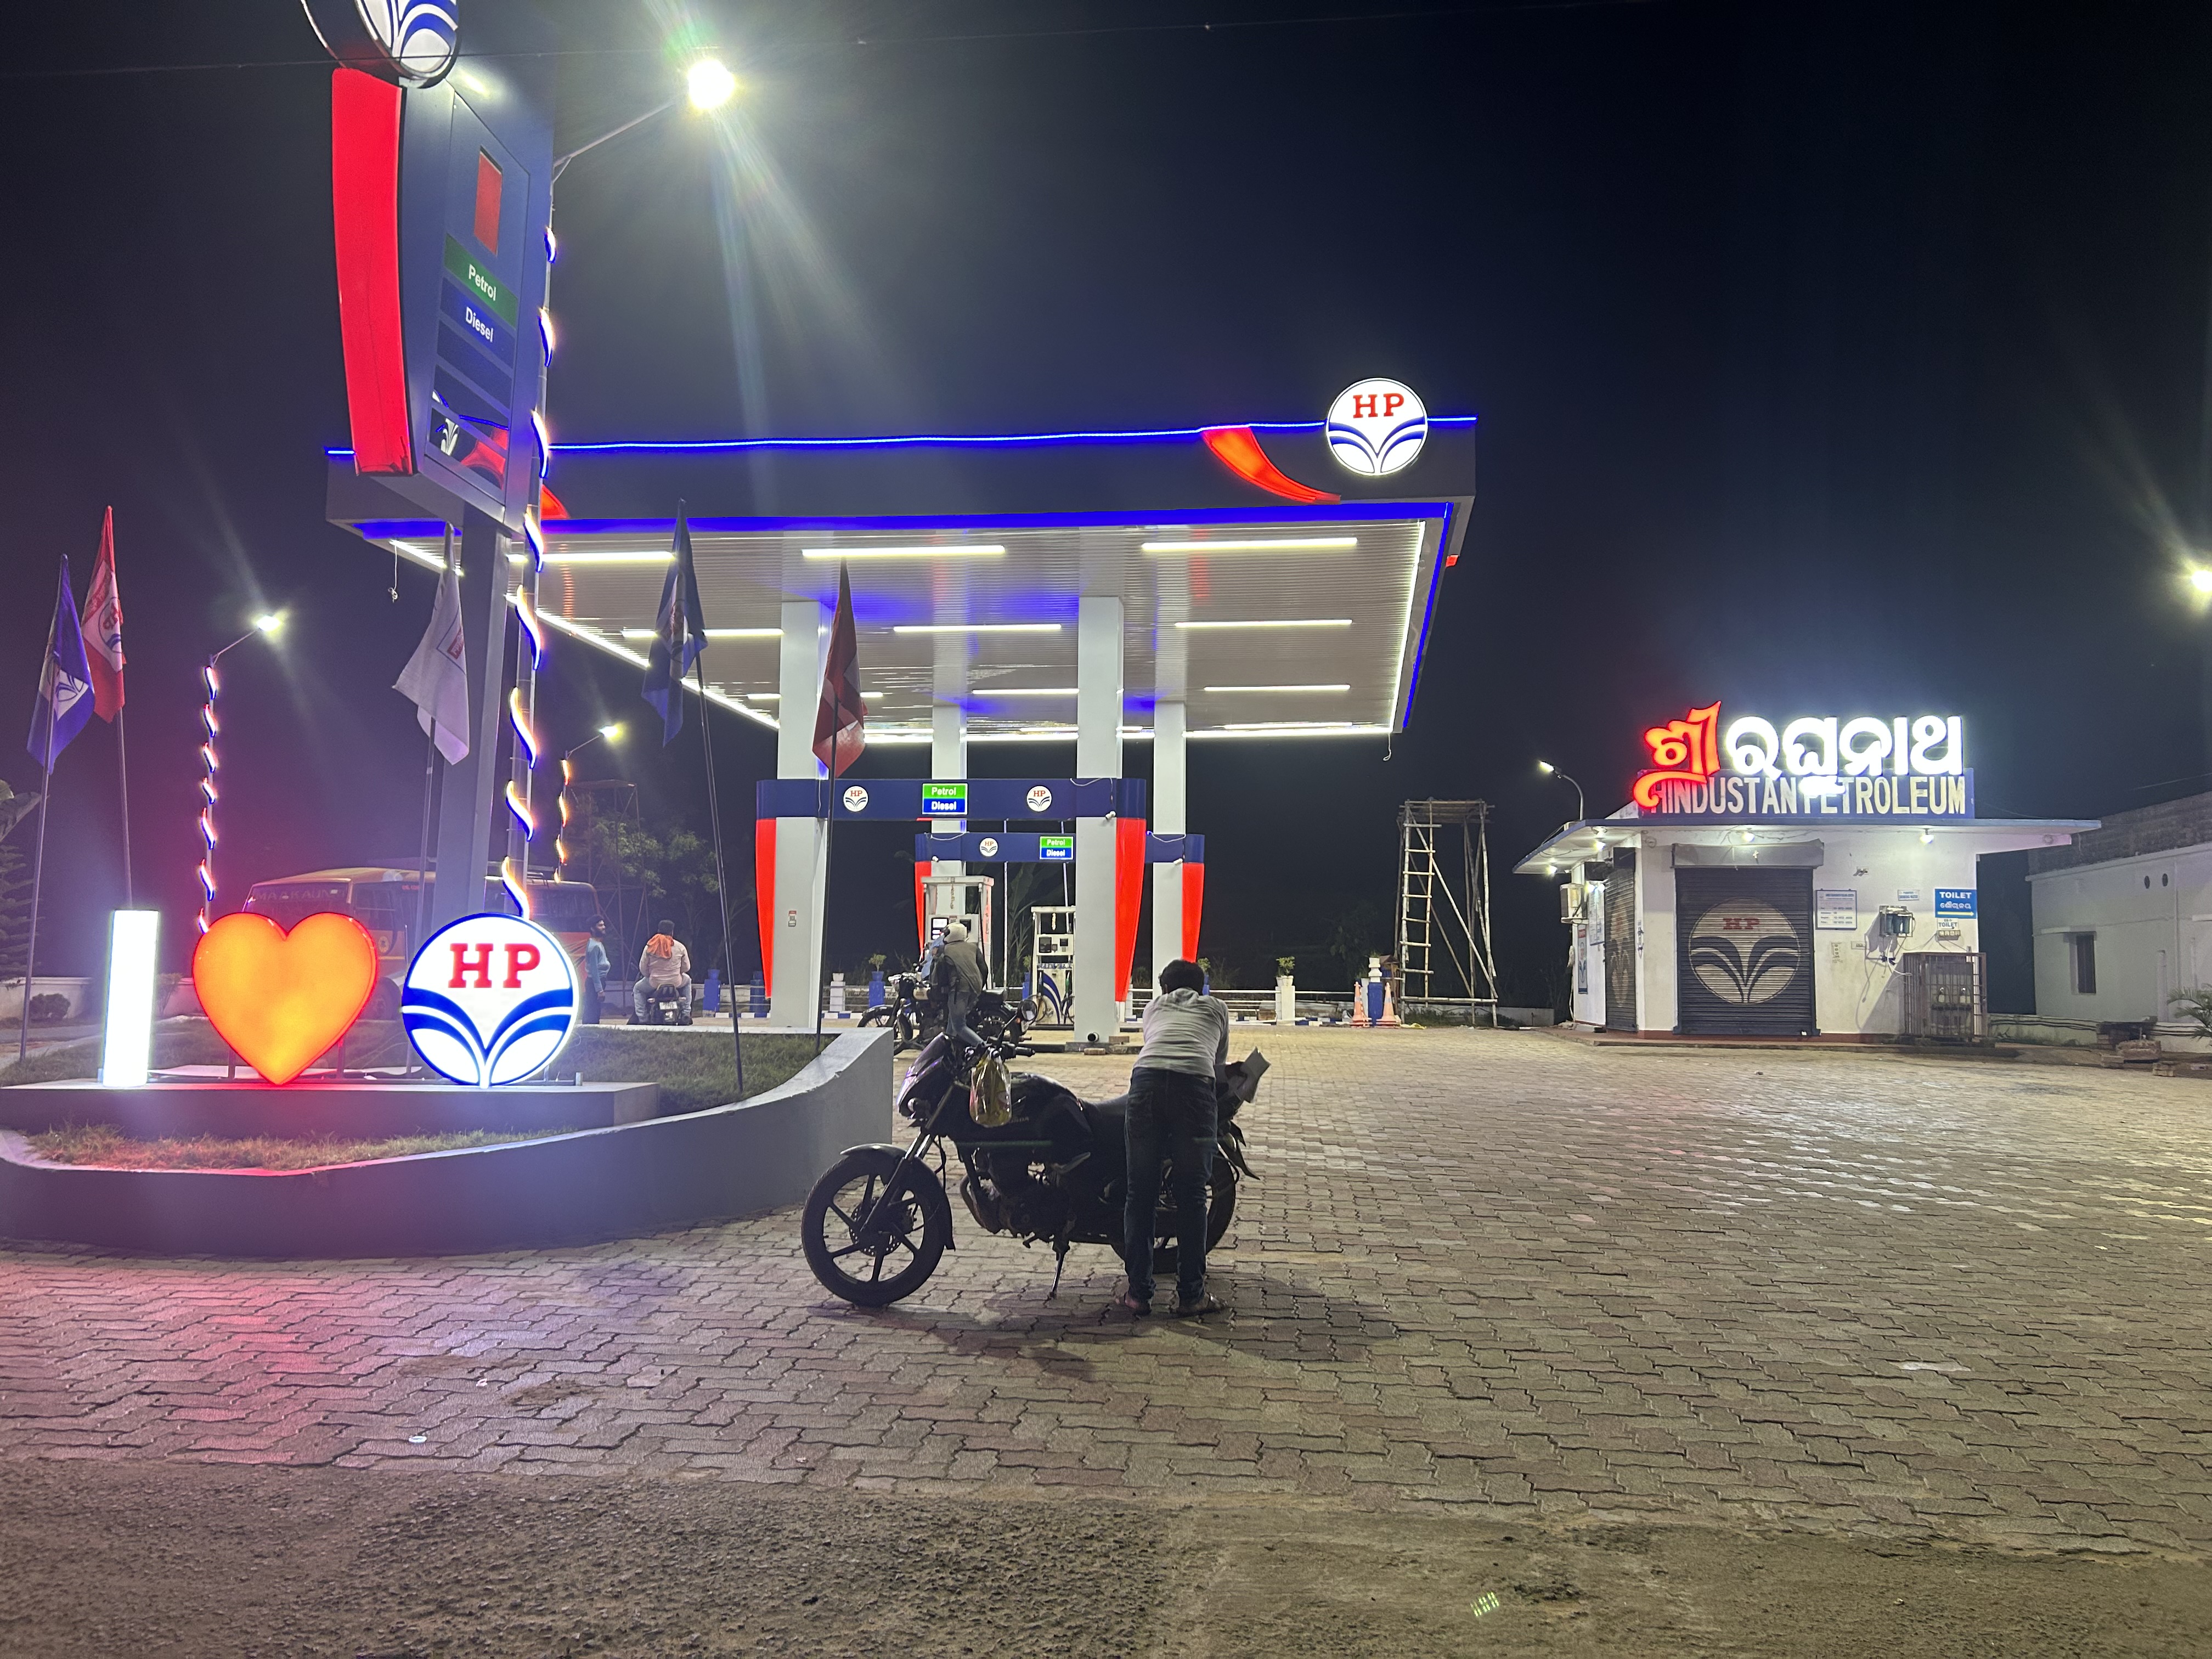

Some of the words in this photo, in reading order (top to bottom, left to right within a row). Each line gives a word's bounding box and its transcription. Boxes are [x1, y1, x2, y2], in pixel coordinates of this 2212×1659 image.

[469, 264, 496, 301] Petrol
[466, 307, 494, 342] Diesel
[1353, 393, 1404, 418] HP
[1633, 701, 1722, 808] ଶ୍ରୀ
[932, 787, 956, 795] Petrol
[932, 801, 957, 810] Diesel
[1651, 777, 1798, 814] HINDUSTAN
[1723, 917, 1760, 930] HP
[448, 943, 540, 988] HP
